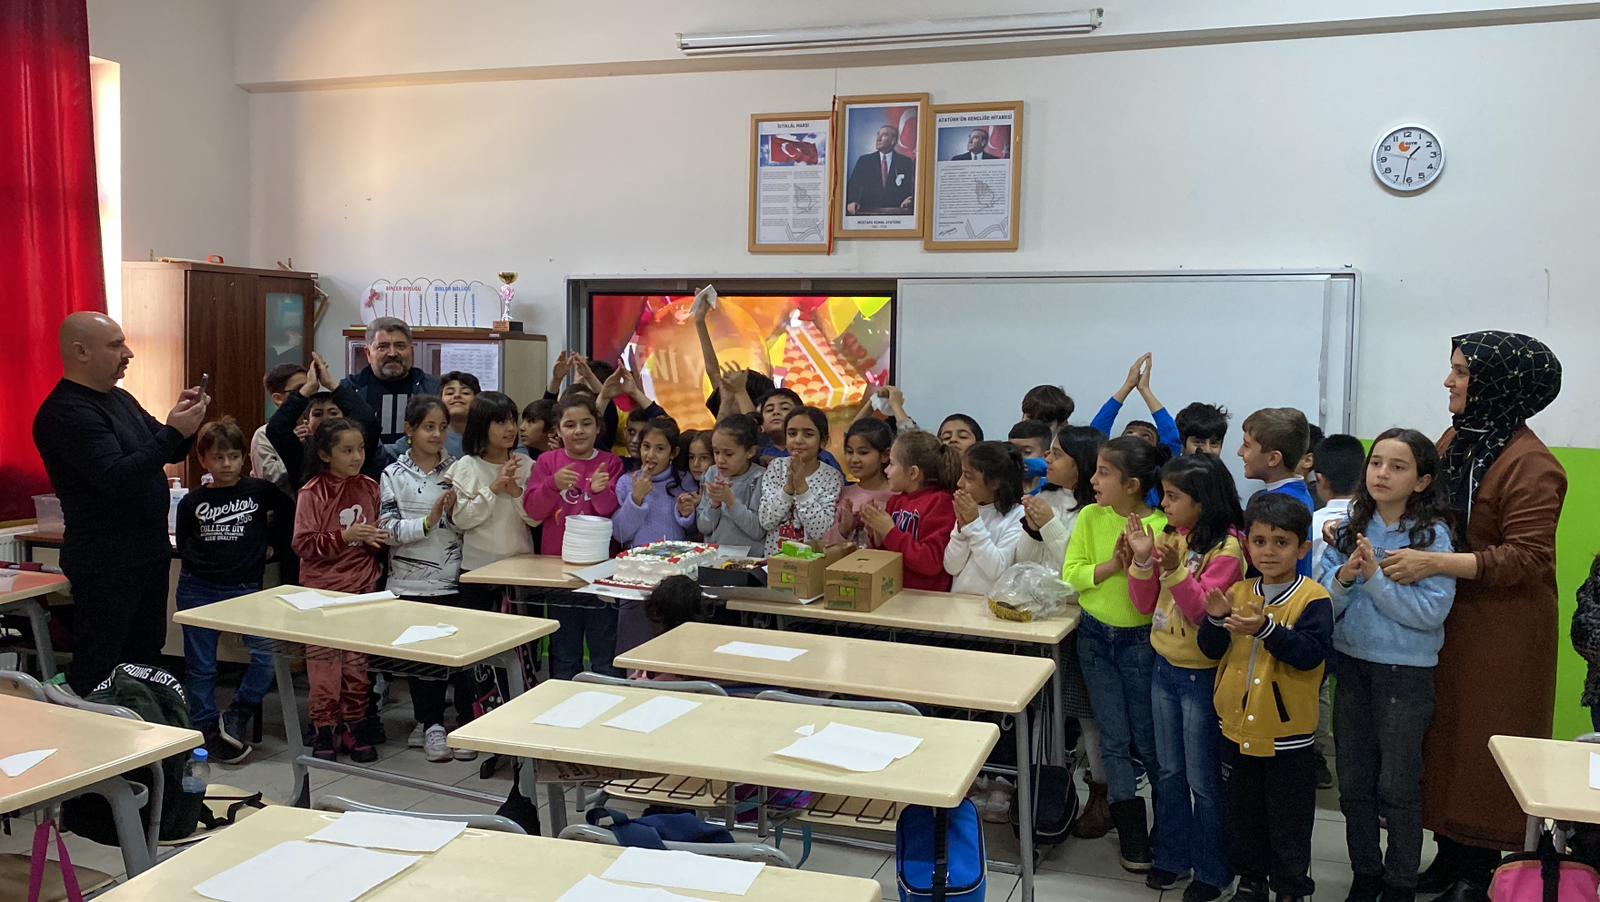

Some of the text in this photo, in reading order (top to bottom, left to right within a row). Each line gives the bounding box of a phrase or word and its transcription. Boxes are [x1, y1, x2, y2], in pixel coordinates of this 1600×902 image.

[195, 496, 259, 525] Superior
[200, 524, 231, 533] COLLEGE
[122, 663, 152, 680] GOING
[150, 669, 177, 686] JUST
